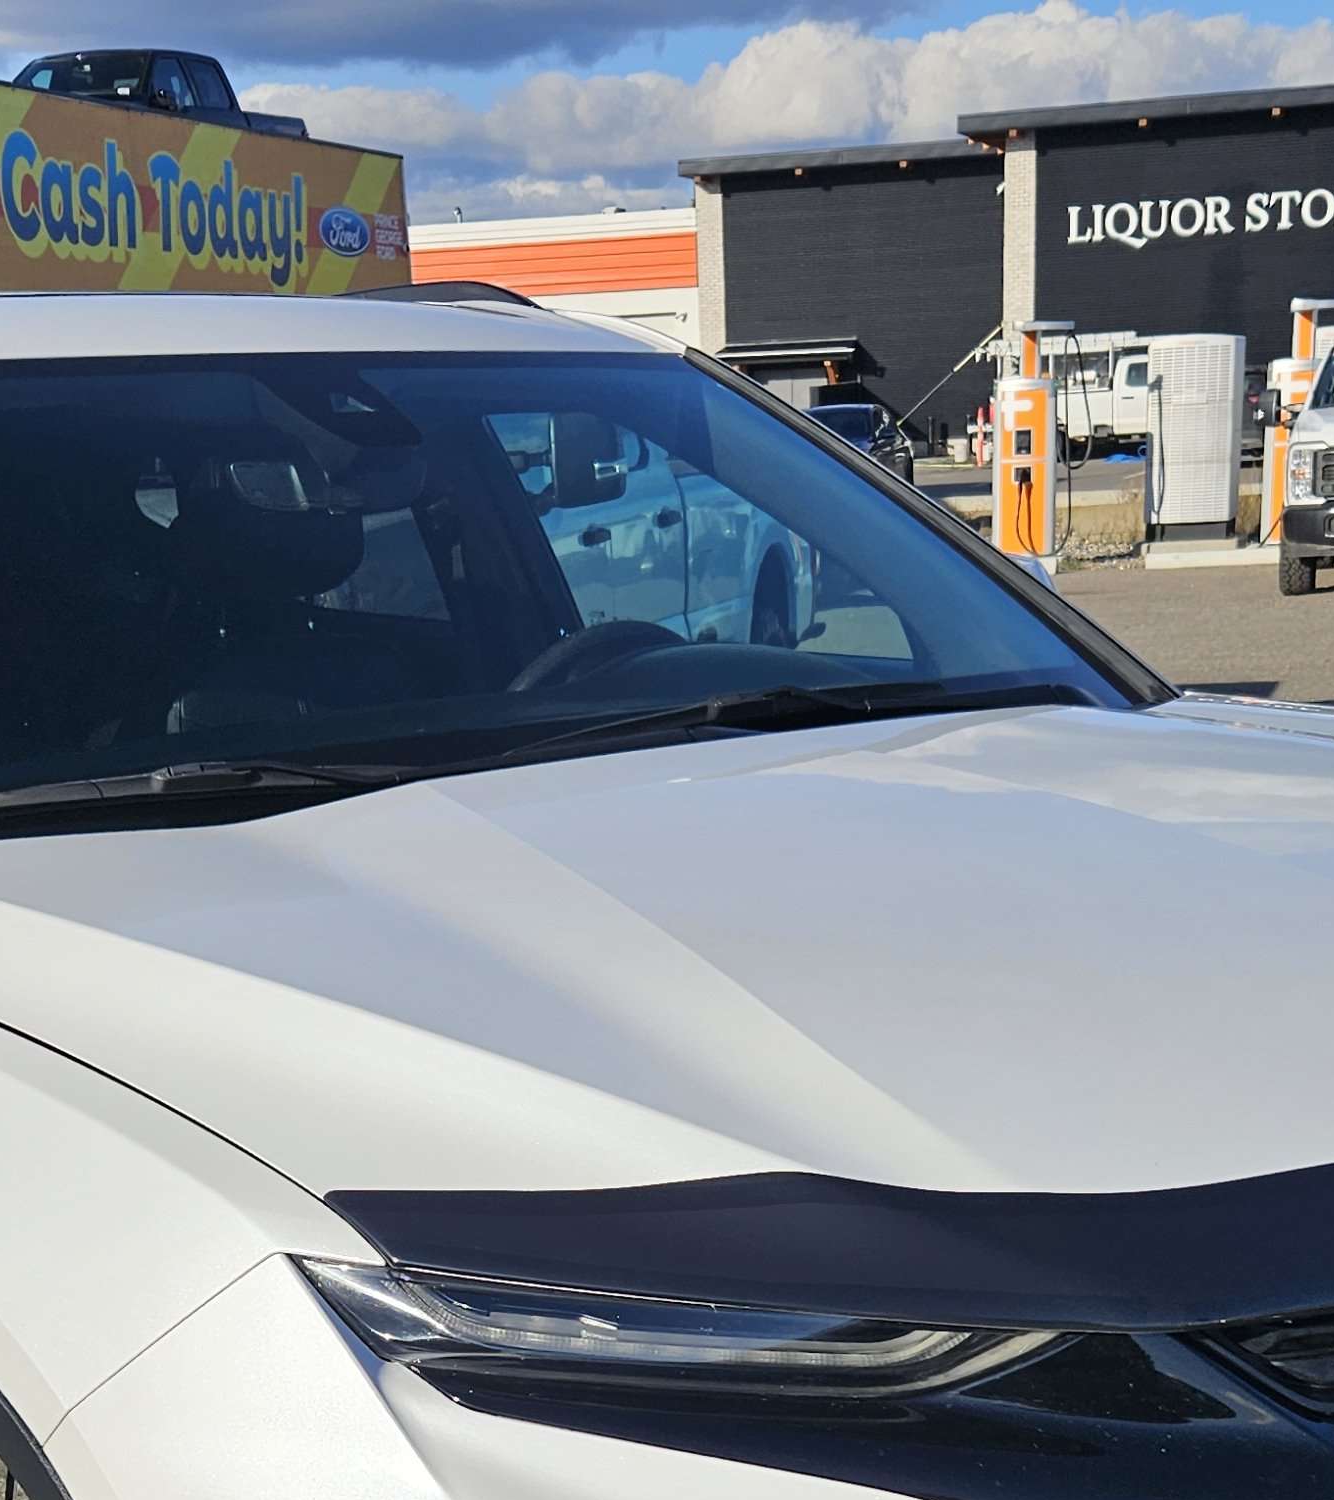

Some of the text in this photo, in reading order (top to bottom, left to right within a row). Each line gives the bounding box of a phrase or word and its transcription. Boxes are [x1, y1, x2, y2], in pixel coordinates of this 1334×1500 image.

[1, 128, 137, 249] Cash
[148, 153, 304, 287] Today!
[327, 212, 364, 250] Ford
[1067, 195, 1235, 249] LIQUOR
